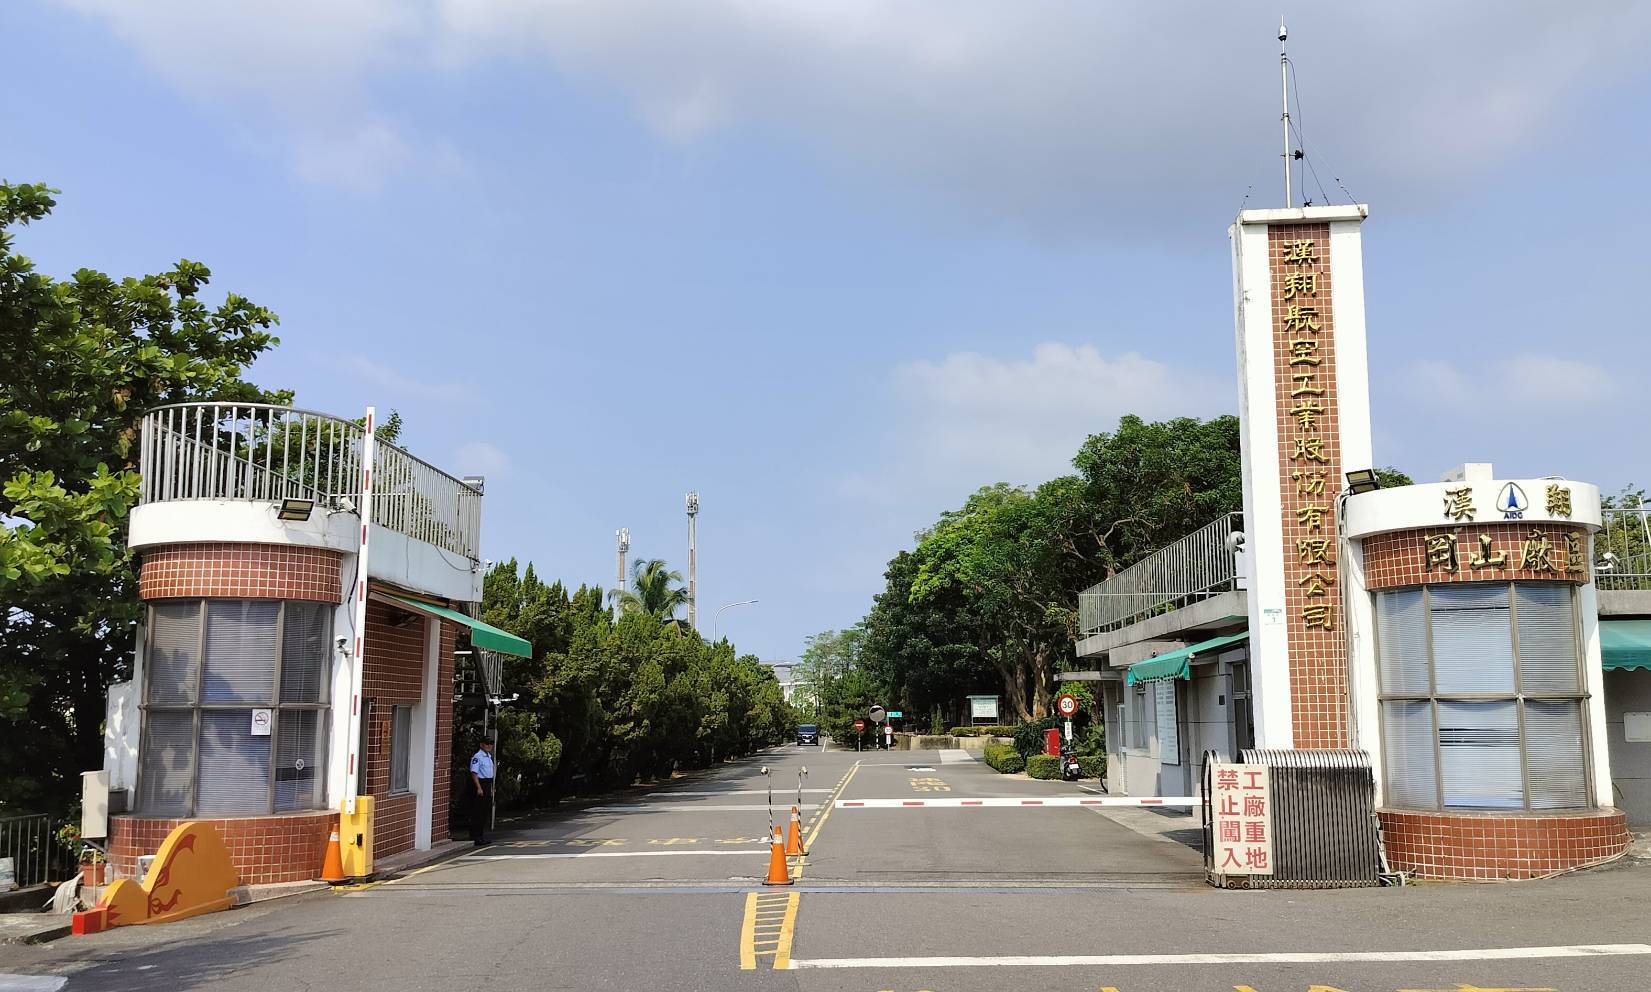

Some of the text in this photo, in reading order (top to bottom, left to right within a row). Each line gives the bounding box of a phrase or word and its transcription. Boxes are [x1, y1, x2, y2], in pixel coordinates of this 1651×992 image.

[1283, 239, 1335, 630] 漢翔航空工業股份有限公司
[1442, 486, 1476, 521] 漢
[1062, 700, 1073, 709] 30
[1217, 768, 1242, 869] 禁止闖入
[1242, 771, 1268, 870] 工廠重地
